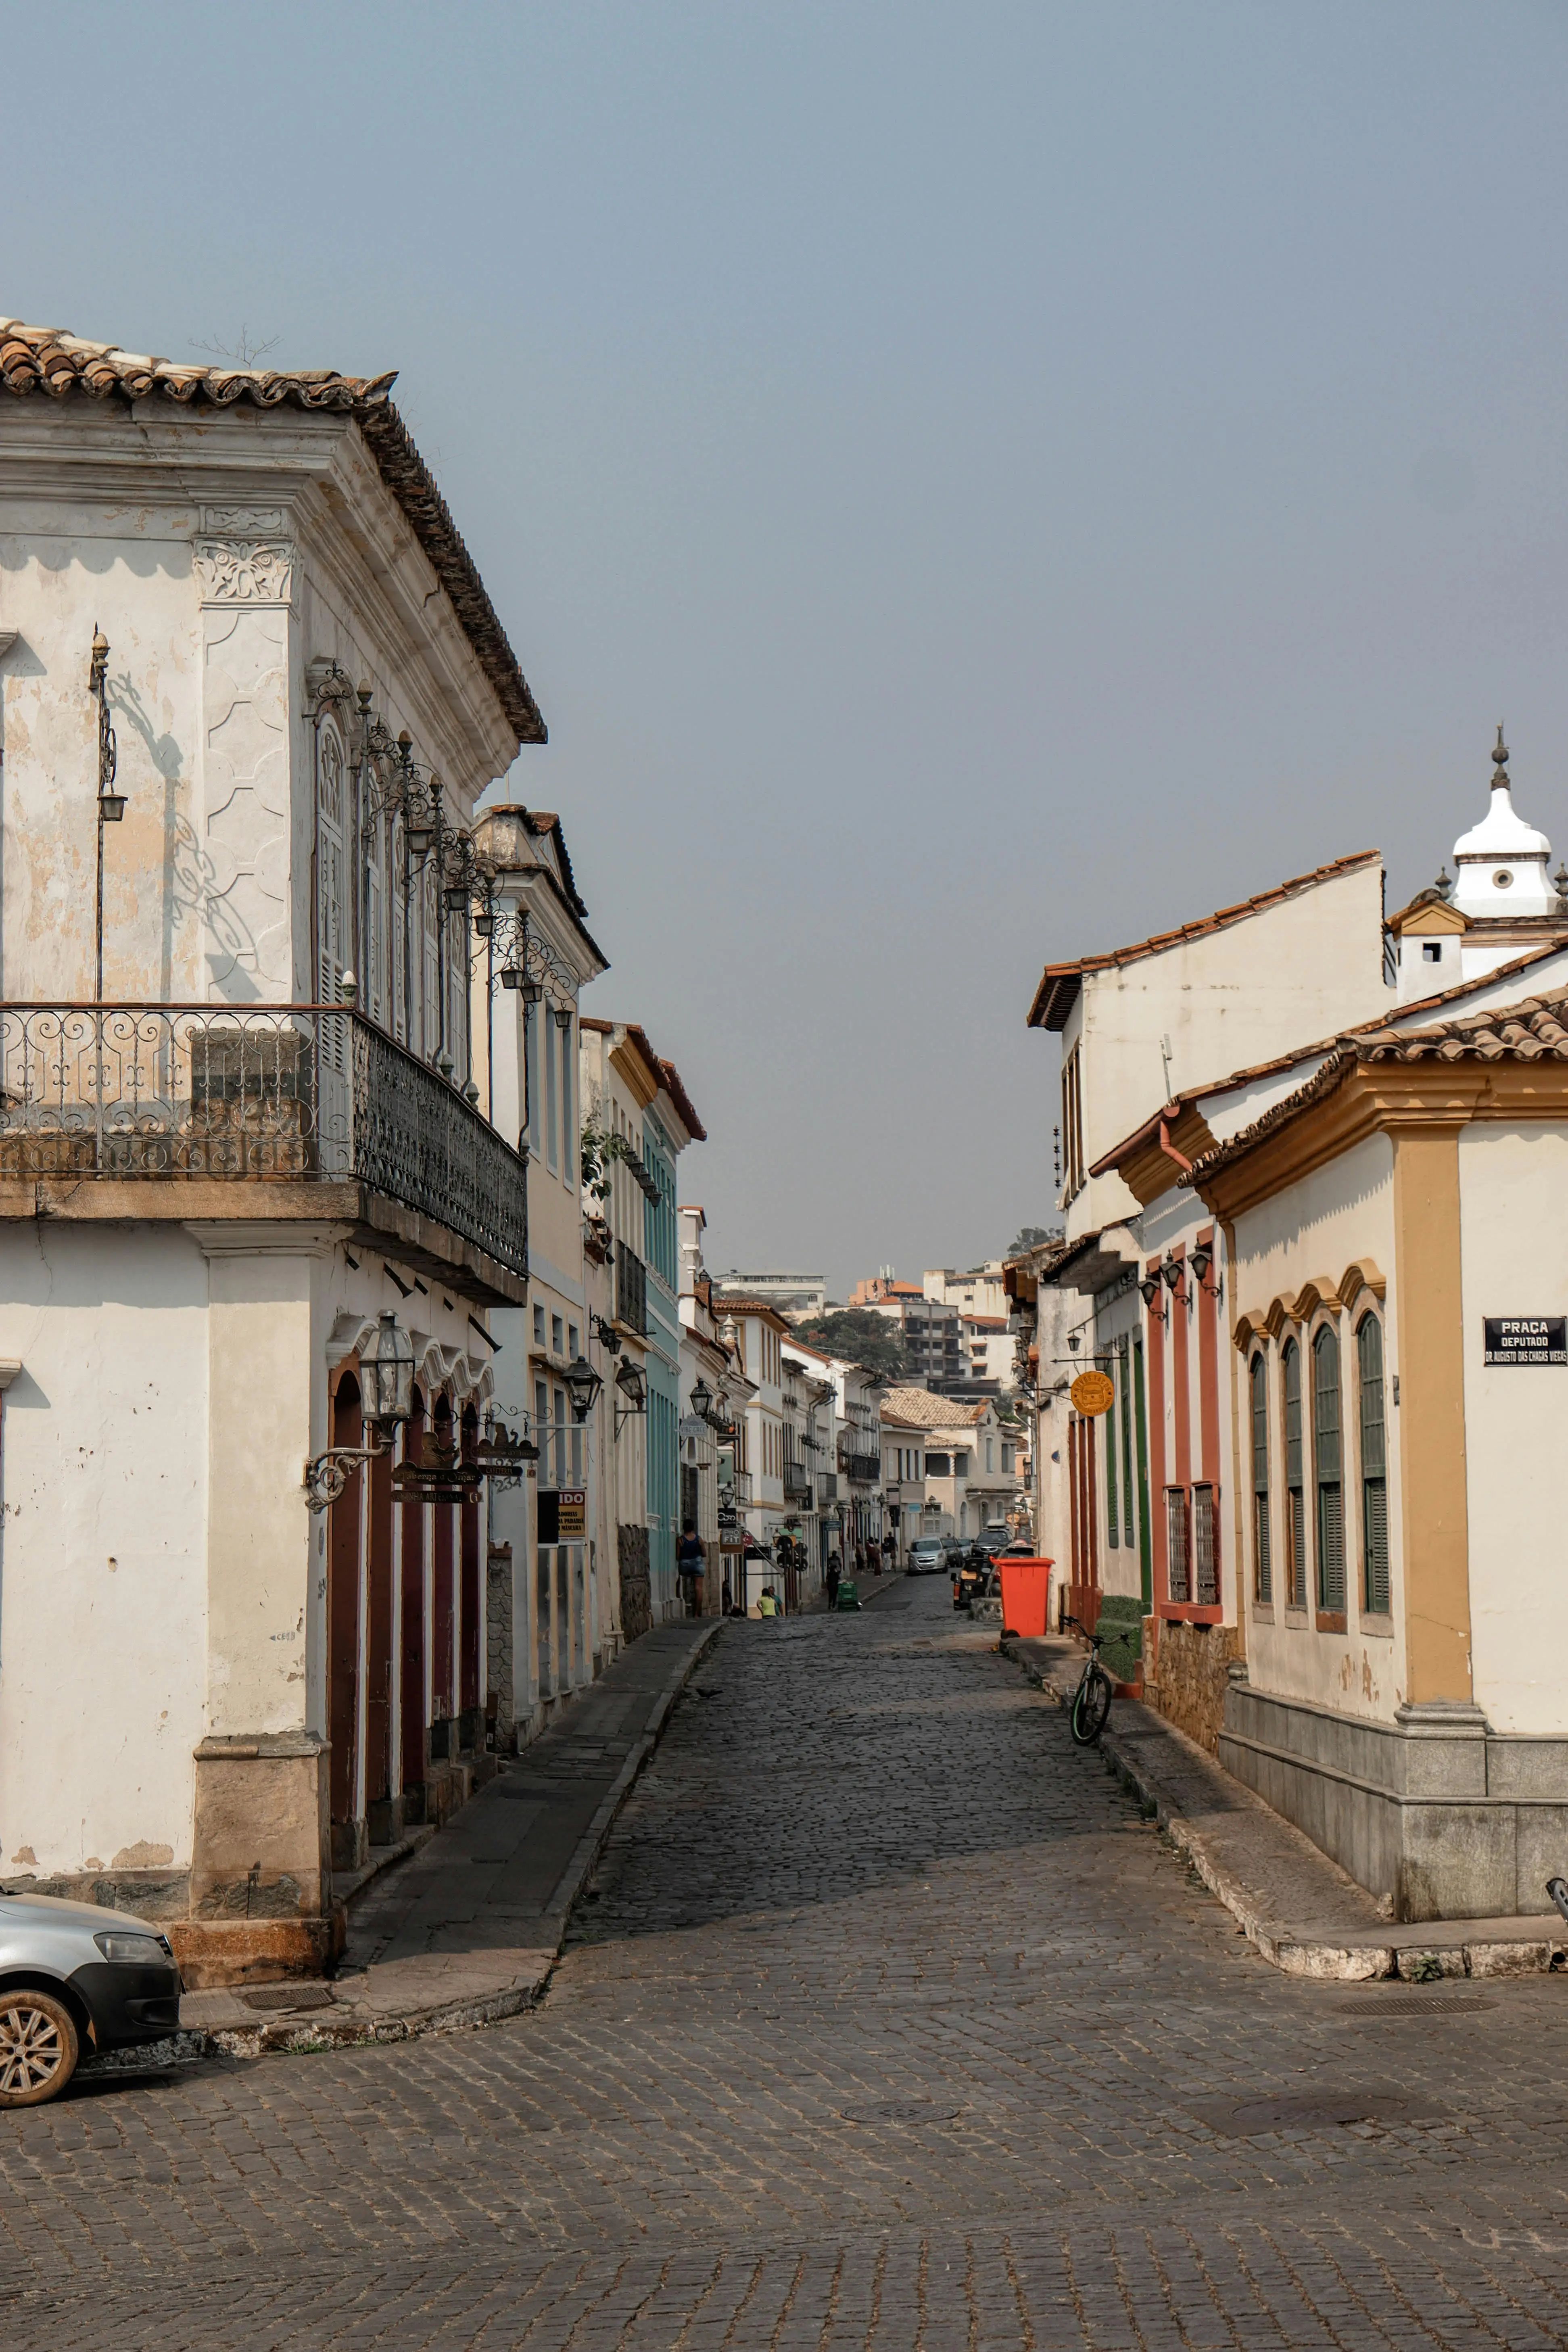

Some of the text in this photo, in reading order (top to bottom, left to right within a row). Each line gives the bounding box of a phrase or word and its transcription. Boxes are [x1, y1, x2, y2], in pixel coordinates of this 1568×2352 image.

[1501, 1322, 1549, 1334] PRAÇA
[1501, 1337, 1548, 1347] DEPUTADO
[1494, 1351, 1517, 1362] AUGUSTO
[1518, 1351, 1528, 1362] DAS
[1528, 1351, 1548, 1362] CHAGAS
[1549, 1350, 1567, 1362] VIEGAS
[1074, 1375, 1111, 1392] NOVOS TACOS
[495, 1476, 522, 1494] 234
